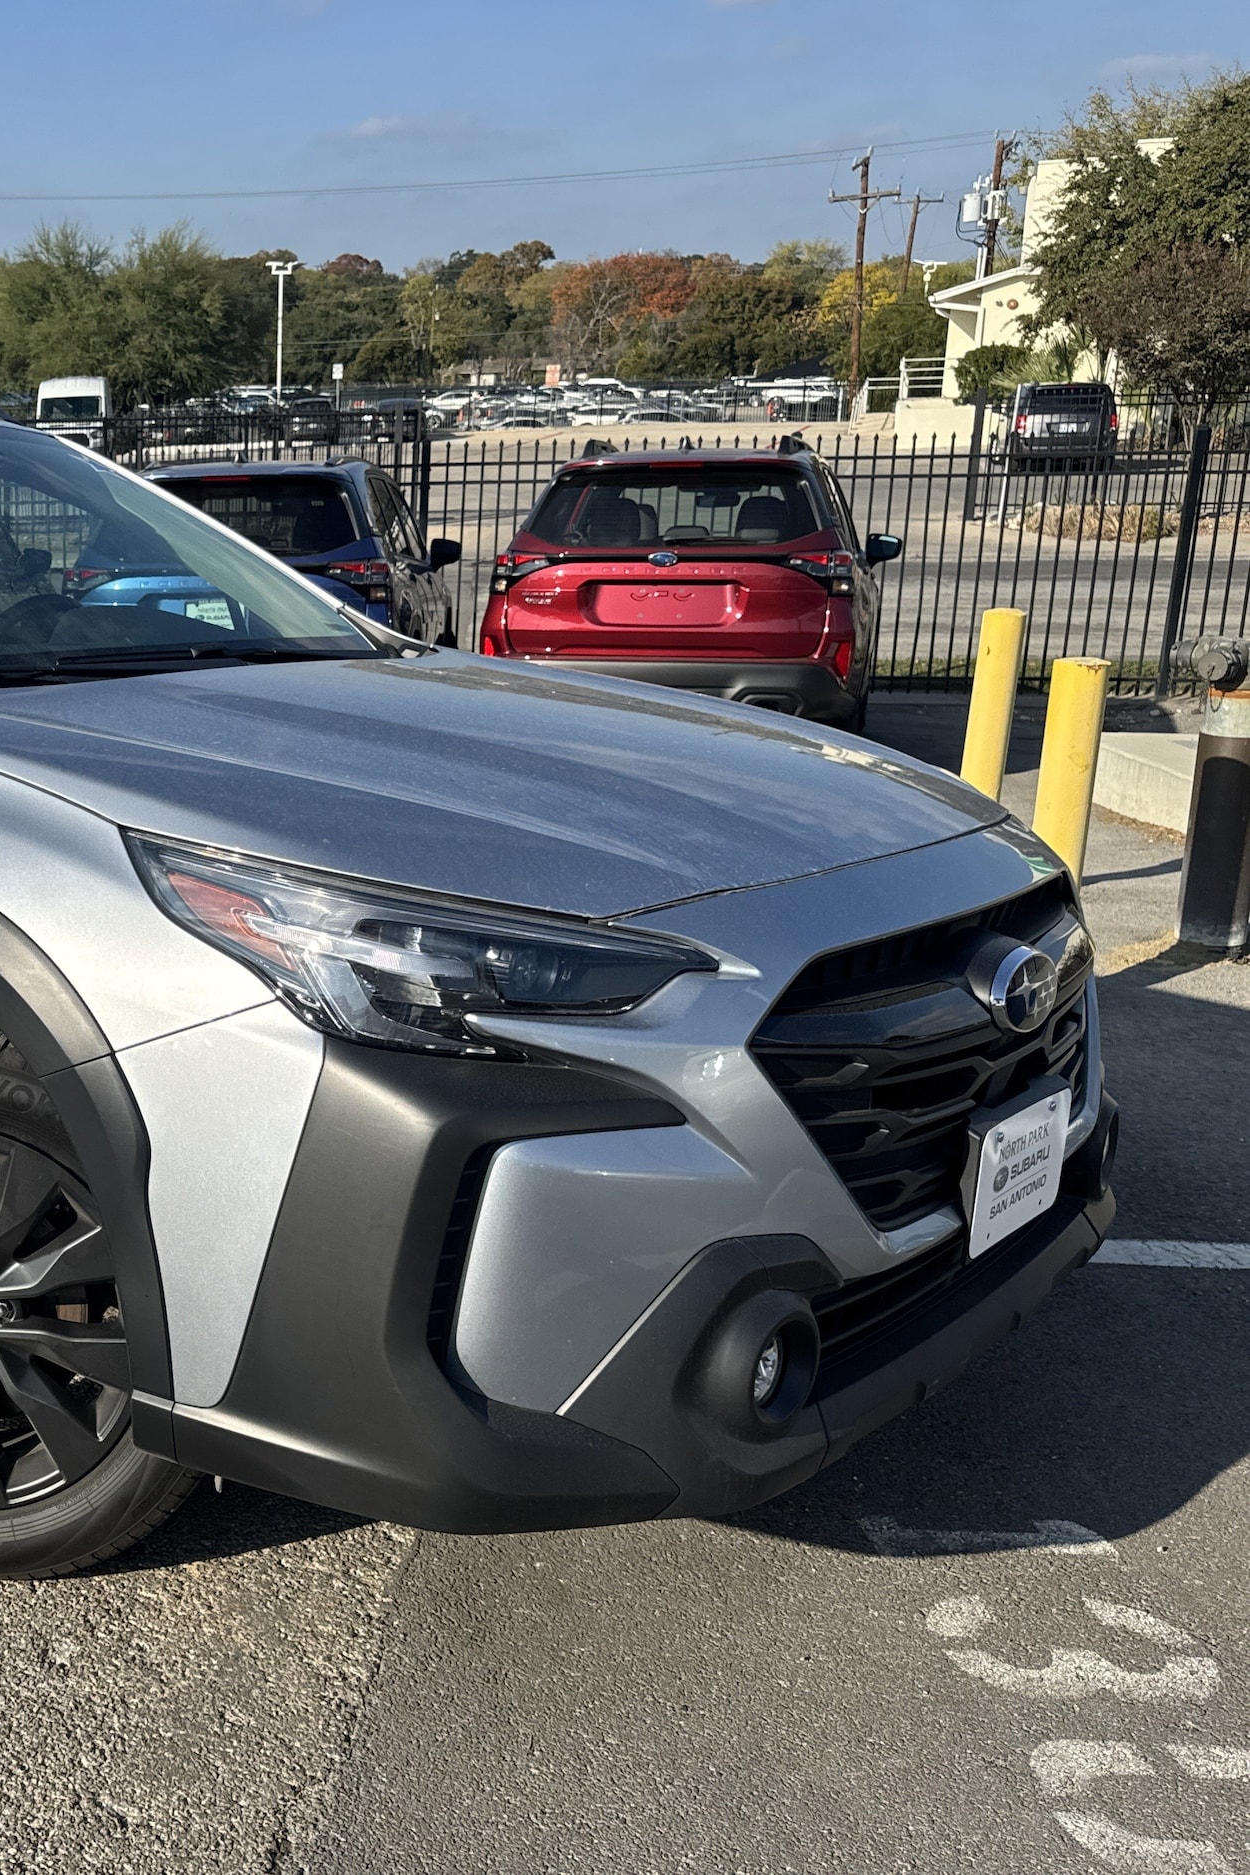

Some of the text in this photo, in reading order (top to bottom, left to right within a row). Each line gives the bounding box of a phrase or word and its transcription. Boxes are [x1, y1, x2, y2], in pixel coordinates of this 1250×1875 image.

[999, 1122, 1050, 1162] NORTH PARK
[1010, 1145, 1050, 1180] SUBARU
[990, 1174, 1047, 1219] SAN ANTONIO
